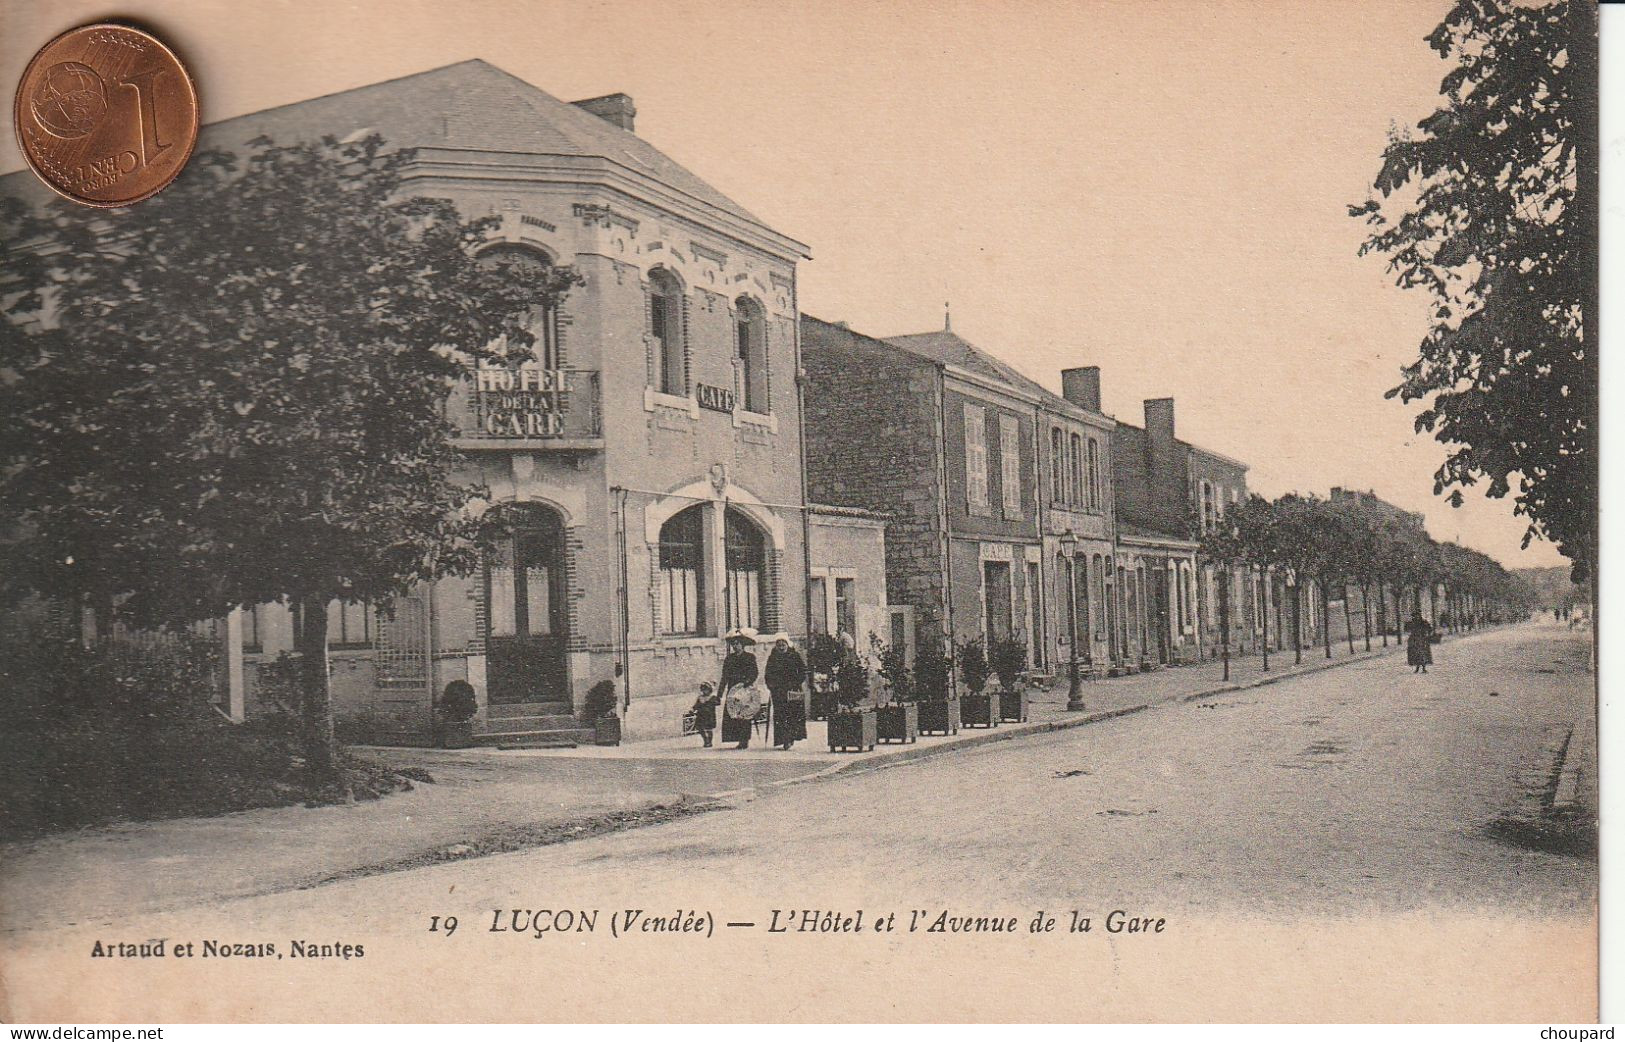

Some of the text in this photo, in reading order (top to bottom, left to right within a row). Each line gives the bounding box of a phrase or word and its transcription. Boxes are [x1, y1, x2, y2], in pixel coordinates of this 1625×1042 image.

[120, 66, 173, 168] 1
[76, 150, 139, 184] CENT
[81, 173, 119, 193] EURO
[502, 396, 549, 410] DE LA
[486, 412, 565, 435] GARE
[429, 915, 458, 938] 19
[489, 909, 599, 939] LUÇON
[768, 909, 863, 934] L'Hôtel
[874, 912, 895, 933] et
[910, 909, 1018, 934] l'Avenue
[1029, 910, 1056, 934] de
[1070, 910, 1092, 934] la
[1106, 909, 1166, 934] Gare
[91, 939, 165, 958] Artaud
[173, 942, 193, 958] et
[290, 940, 365, 959] Nantes
